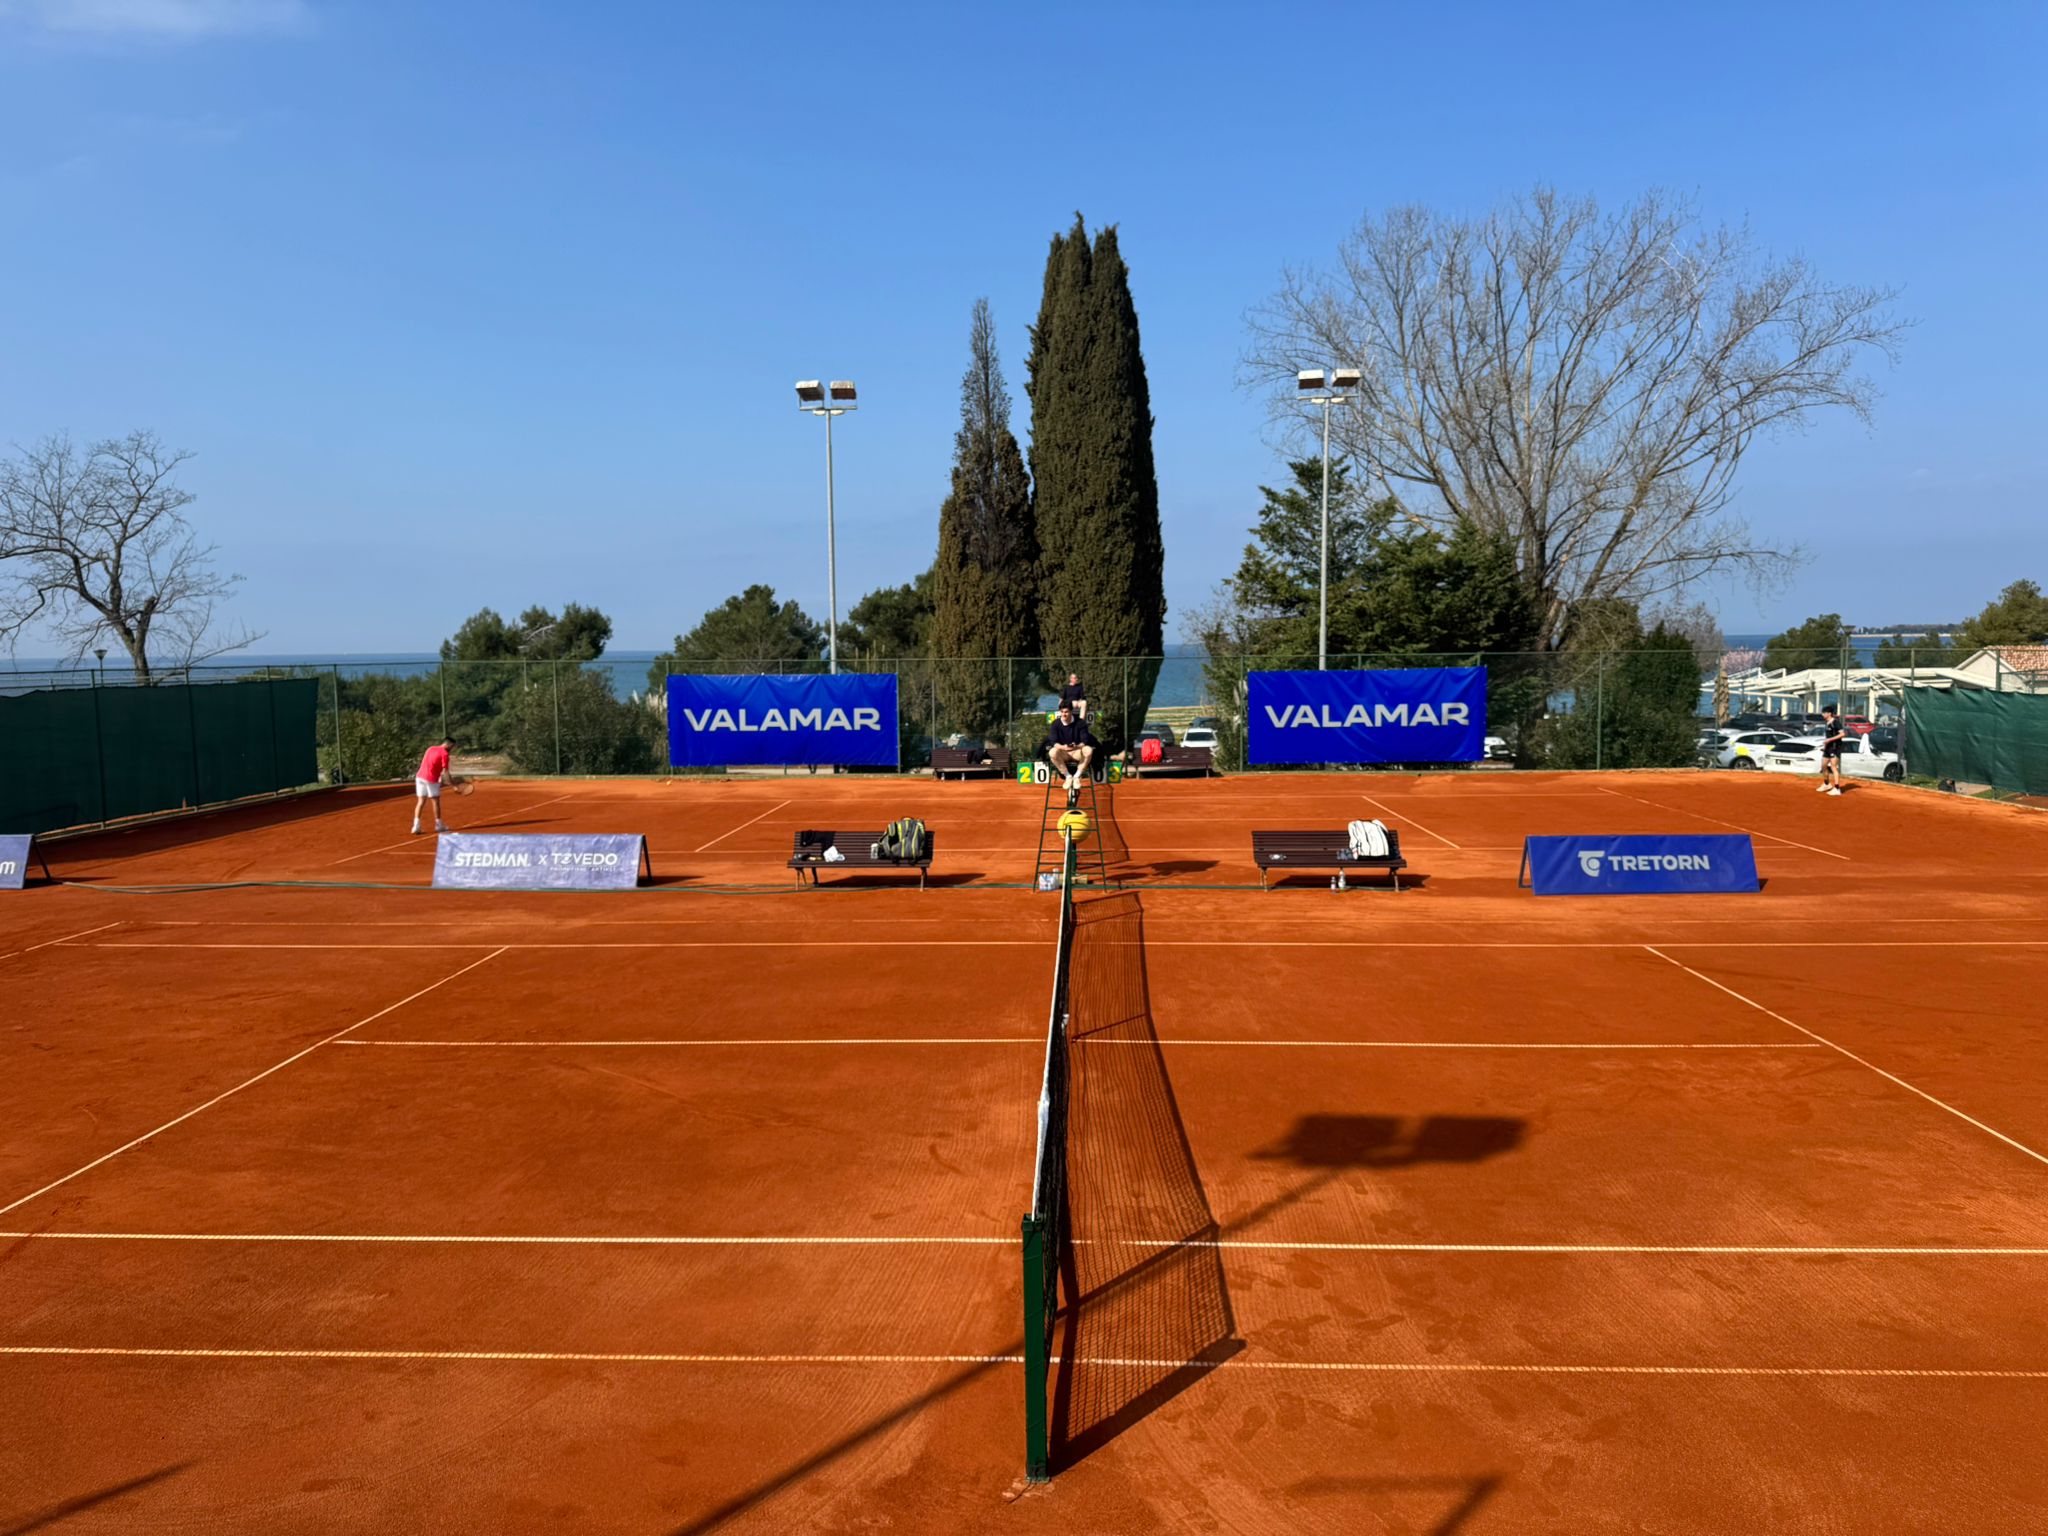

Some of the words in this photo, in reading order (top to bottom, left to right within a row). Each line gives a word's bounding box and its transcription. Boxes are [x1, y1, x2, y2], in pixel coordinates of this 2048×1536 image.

[683, 707, 881, 732] VALAMAR
[1264, 702, 1470, 728] VALAMAR
[1020, 767, 1031, 783] 2
[1037, 769, 1047, 782] 0
[1109, 766, 1120, 782] 3
[1608, 854, 1711, 871] TRETORN
